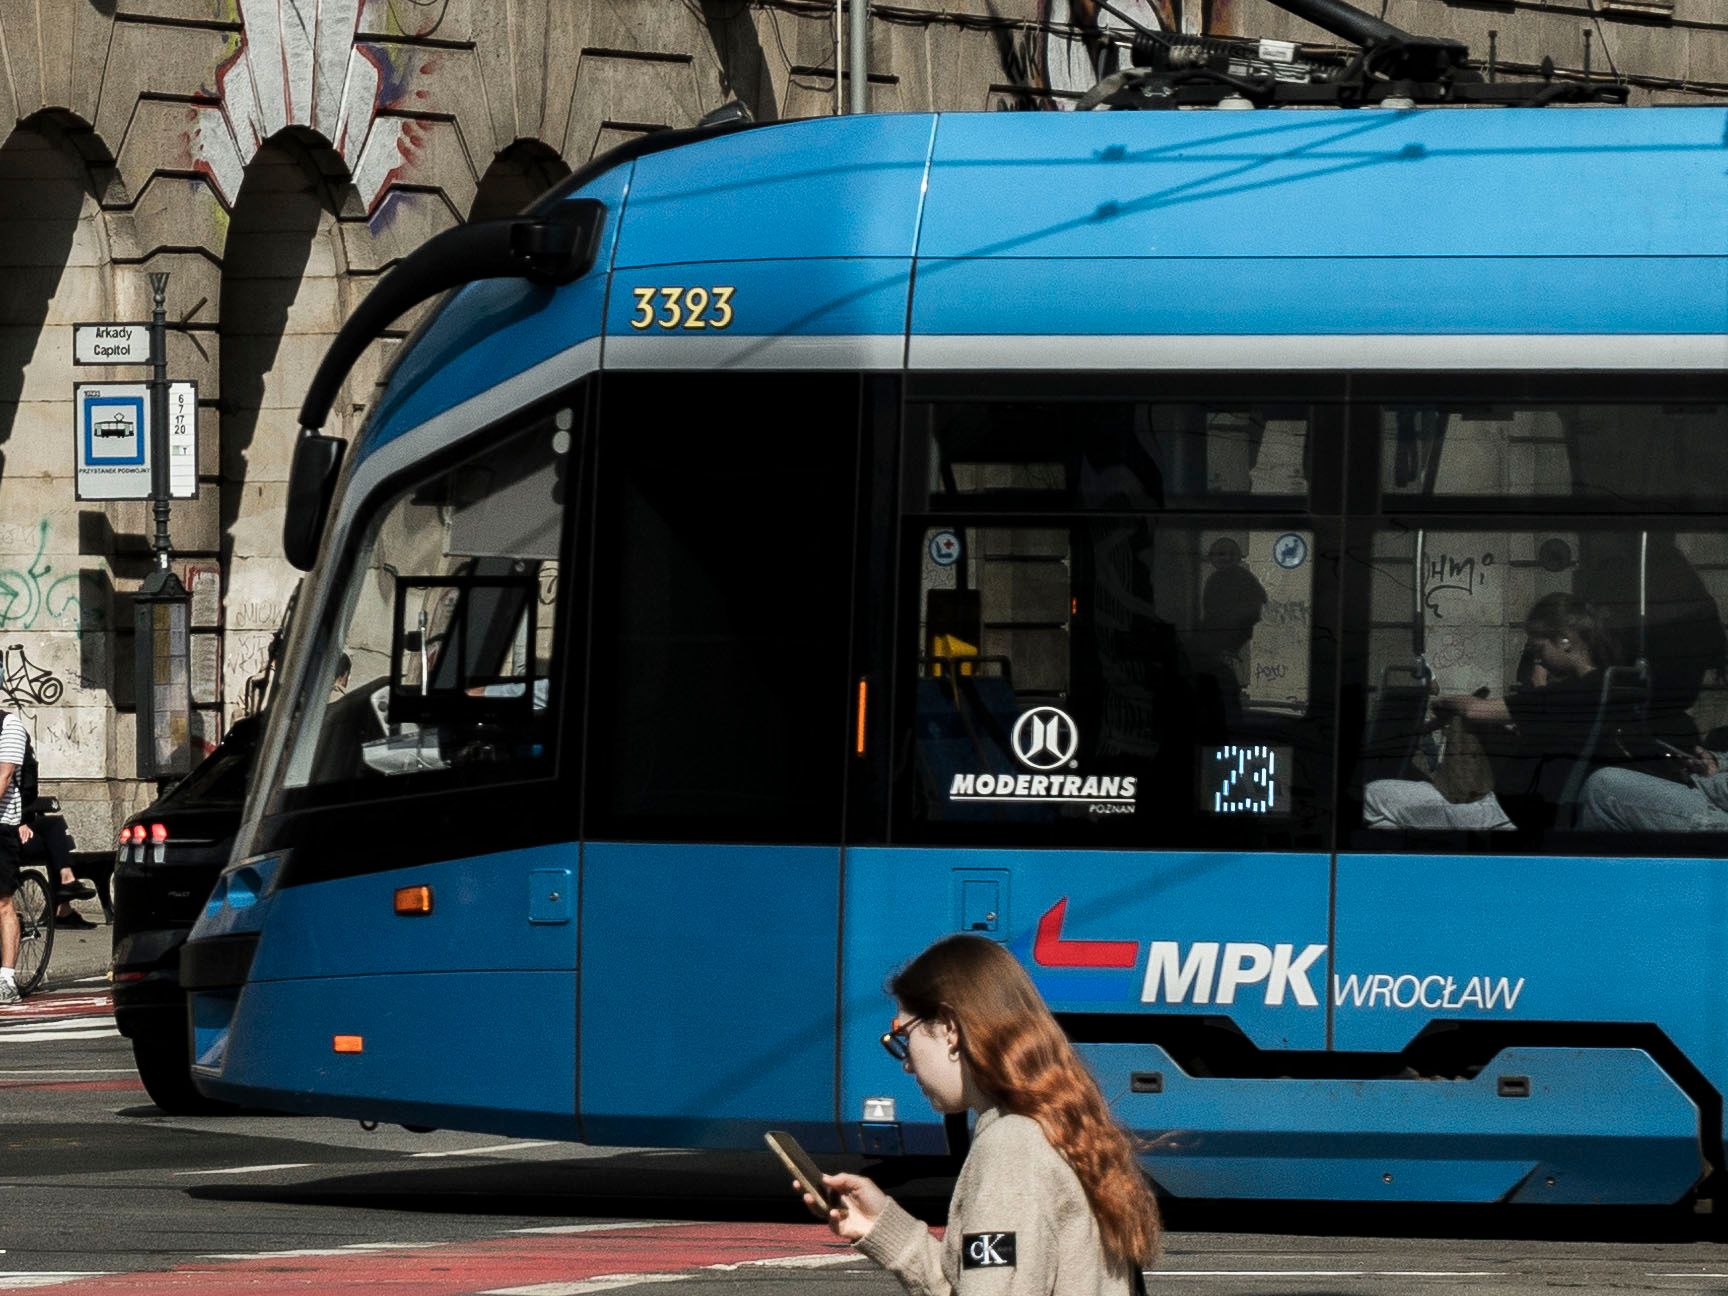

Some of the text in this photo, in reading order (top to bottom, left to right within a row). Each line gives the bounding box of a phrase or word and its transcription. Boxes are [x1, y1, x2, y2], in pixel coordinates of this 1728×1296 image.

[630, 286, 735, 331] 3323
[95, 327, 133, 340] Arkady
[93, 344, 131, 358] Capitol
[178, 394, 185, 403] 6
[178, 405, 185, 414] 7
[175, 415, 186, 424] 17
[174, 425, 187, 435] 20
[949, 773, 1137, 797] MODERTRANS
[1214, 745, 1276, 815] 23
[1141, 940, 1525, 1010] MPK WROCŁAW
